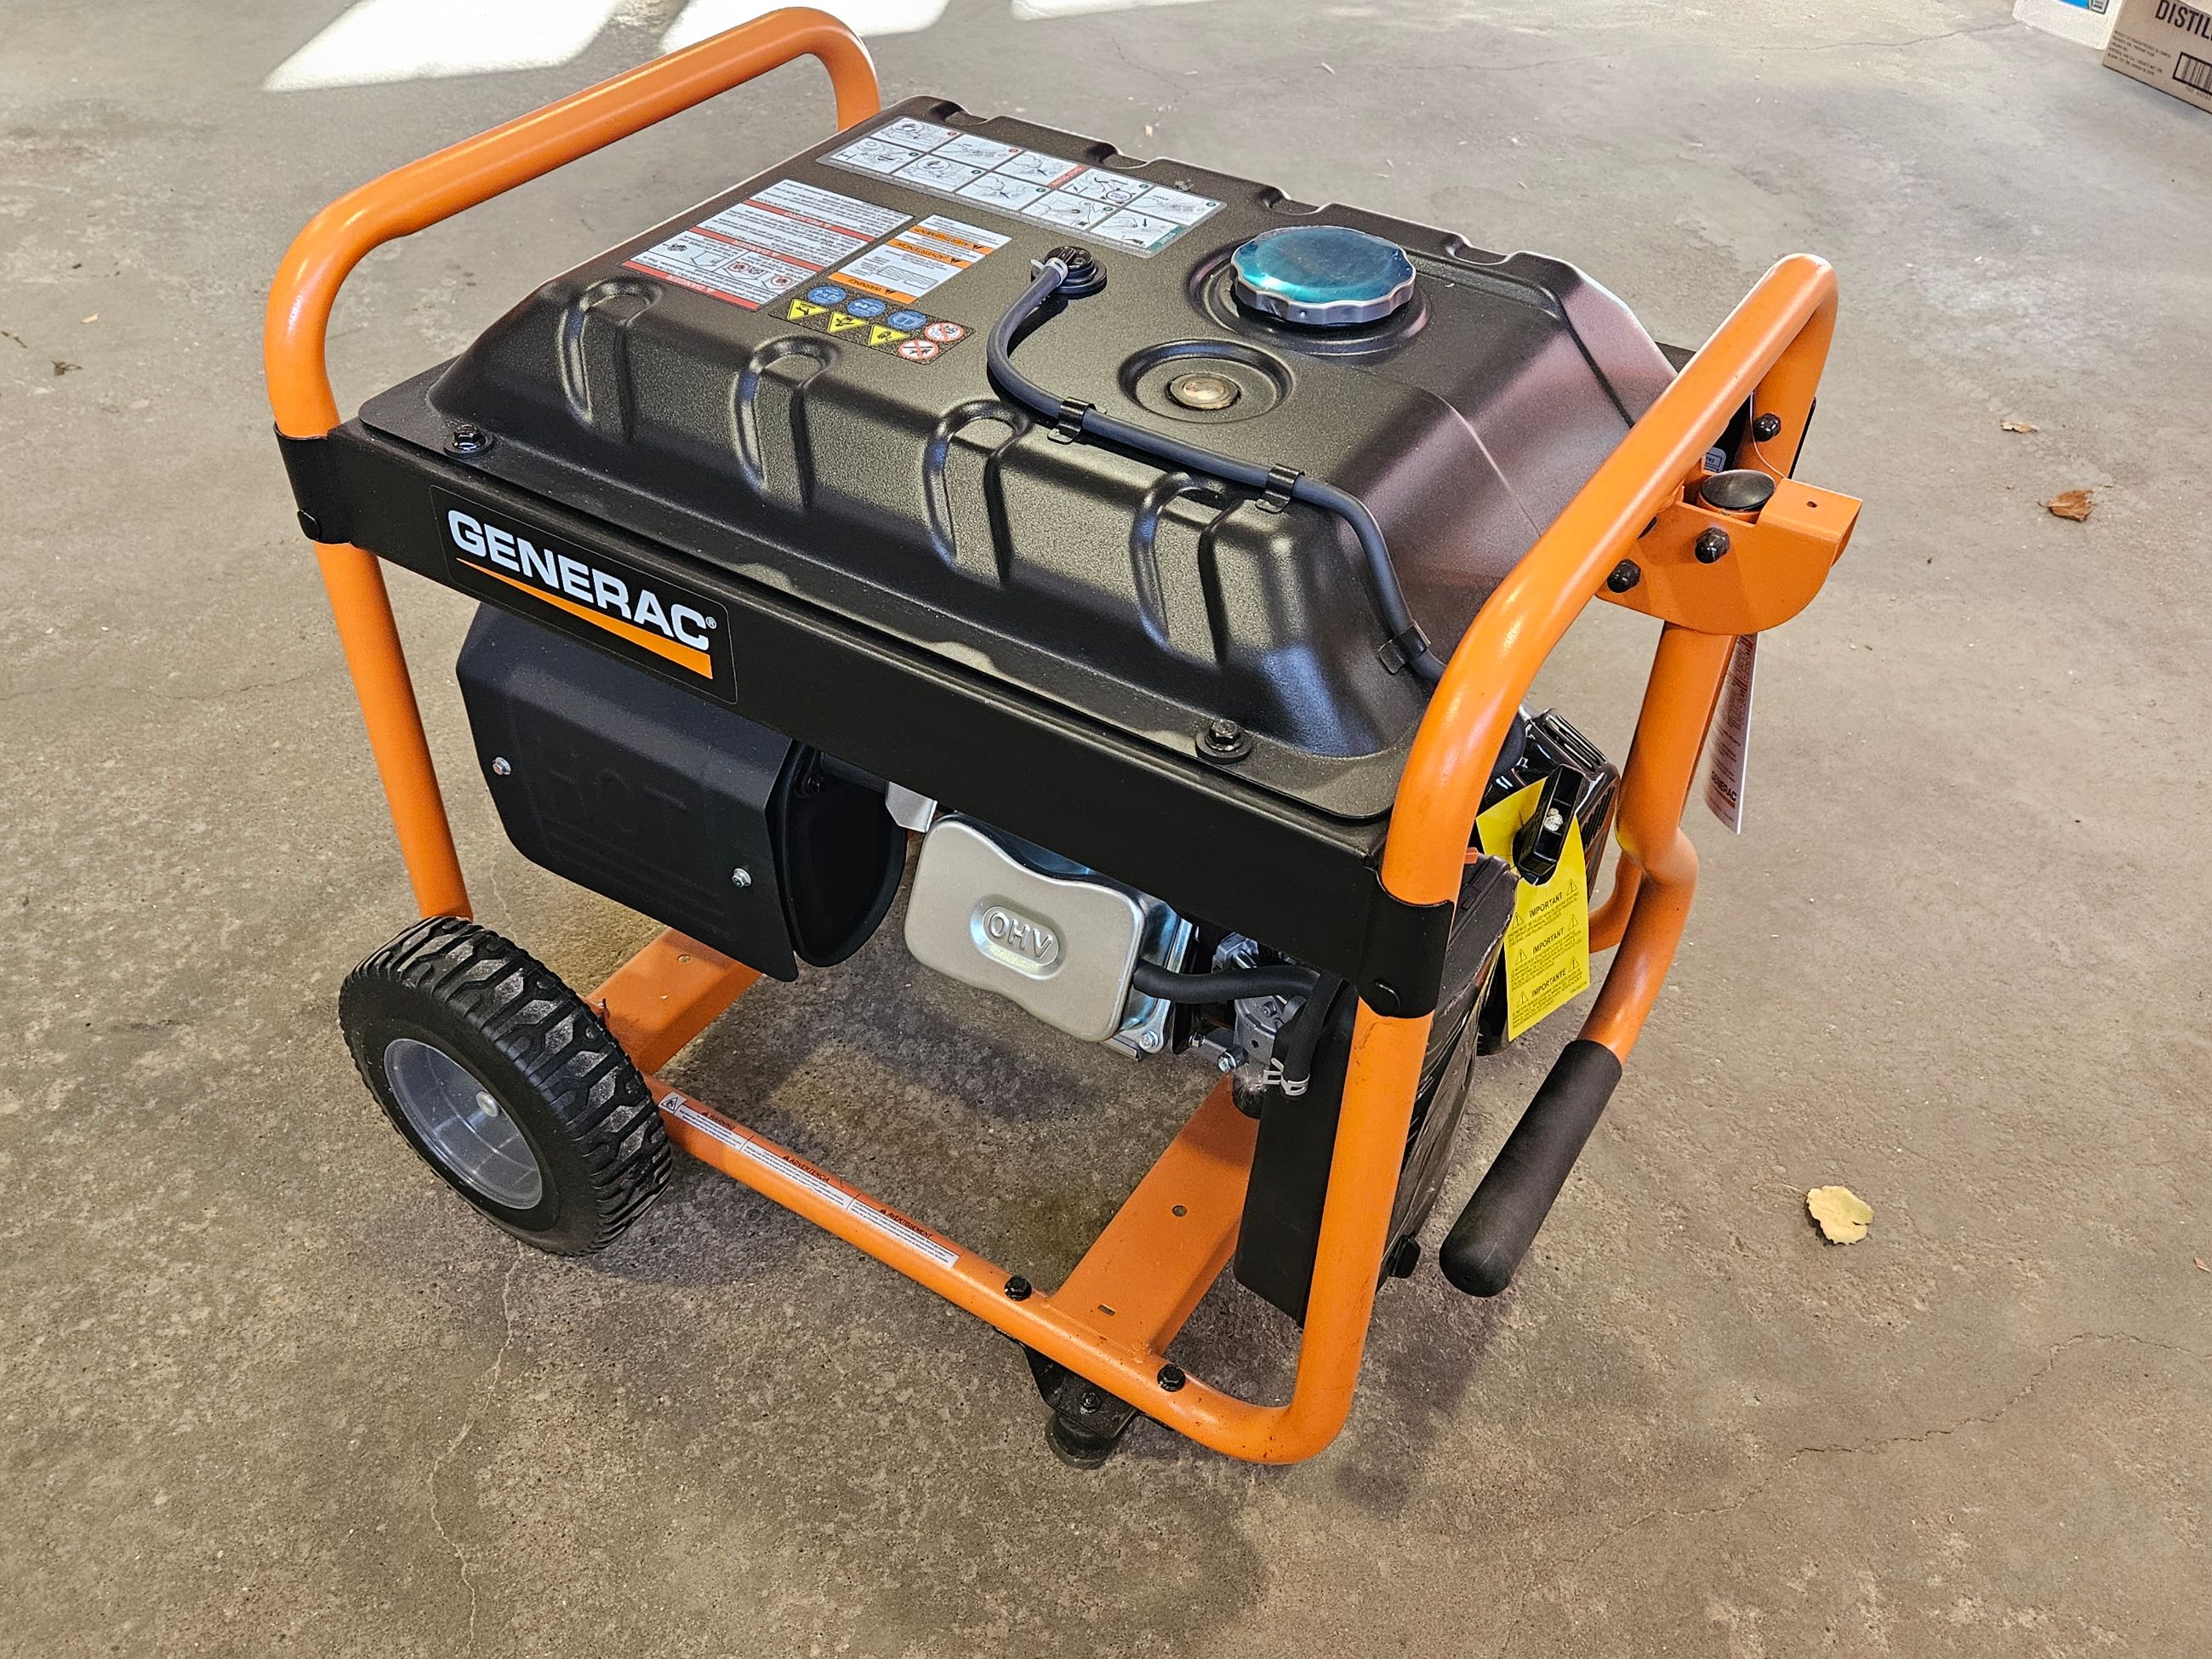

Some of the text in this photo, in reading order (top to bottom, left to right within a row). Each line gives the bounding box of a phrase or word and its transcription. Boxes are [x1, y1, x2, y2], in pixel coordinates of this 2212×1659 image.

[2155, 0, 2212, 41] DISTIL
[733, 240, 771, 255] DANGER
[666, 275, 707, 291] DANGER
[1529, 892, 1564, 917] IMPORTANT
[988, 910, 1054, 961] OHV
[1532, 926, 1565, 955] IMPORTANT
[1531, 968, 1567, 998] IMPORTANTE
[789, 1158, 830, 1183] ADVERTENCIA
